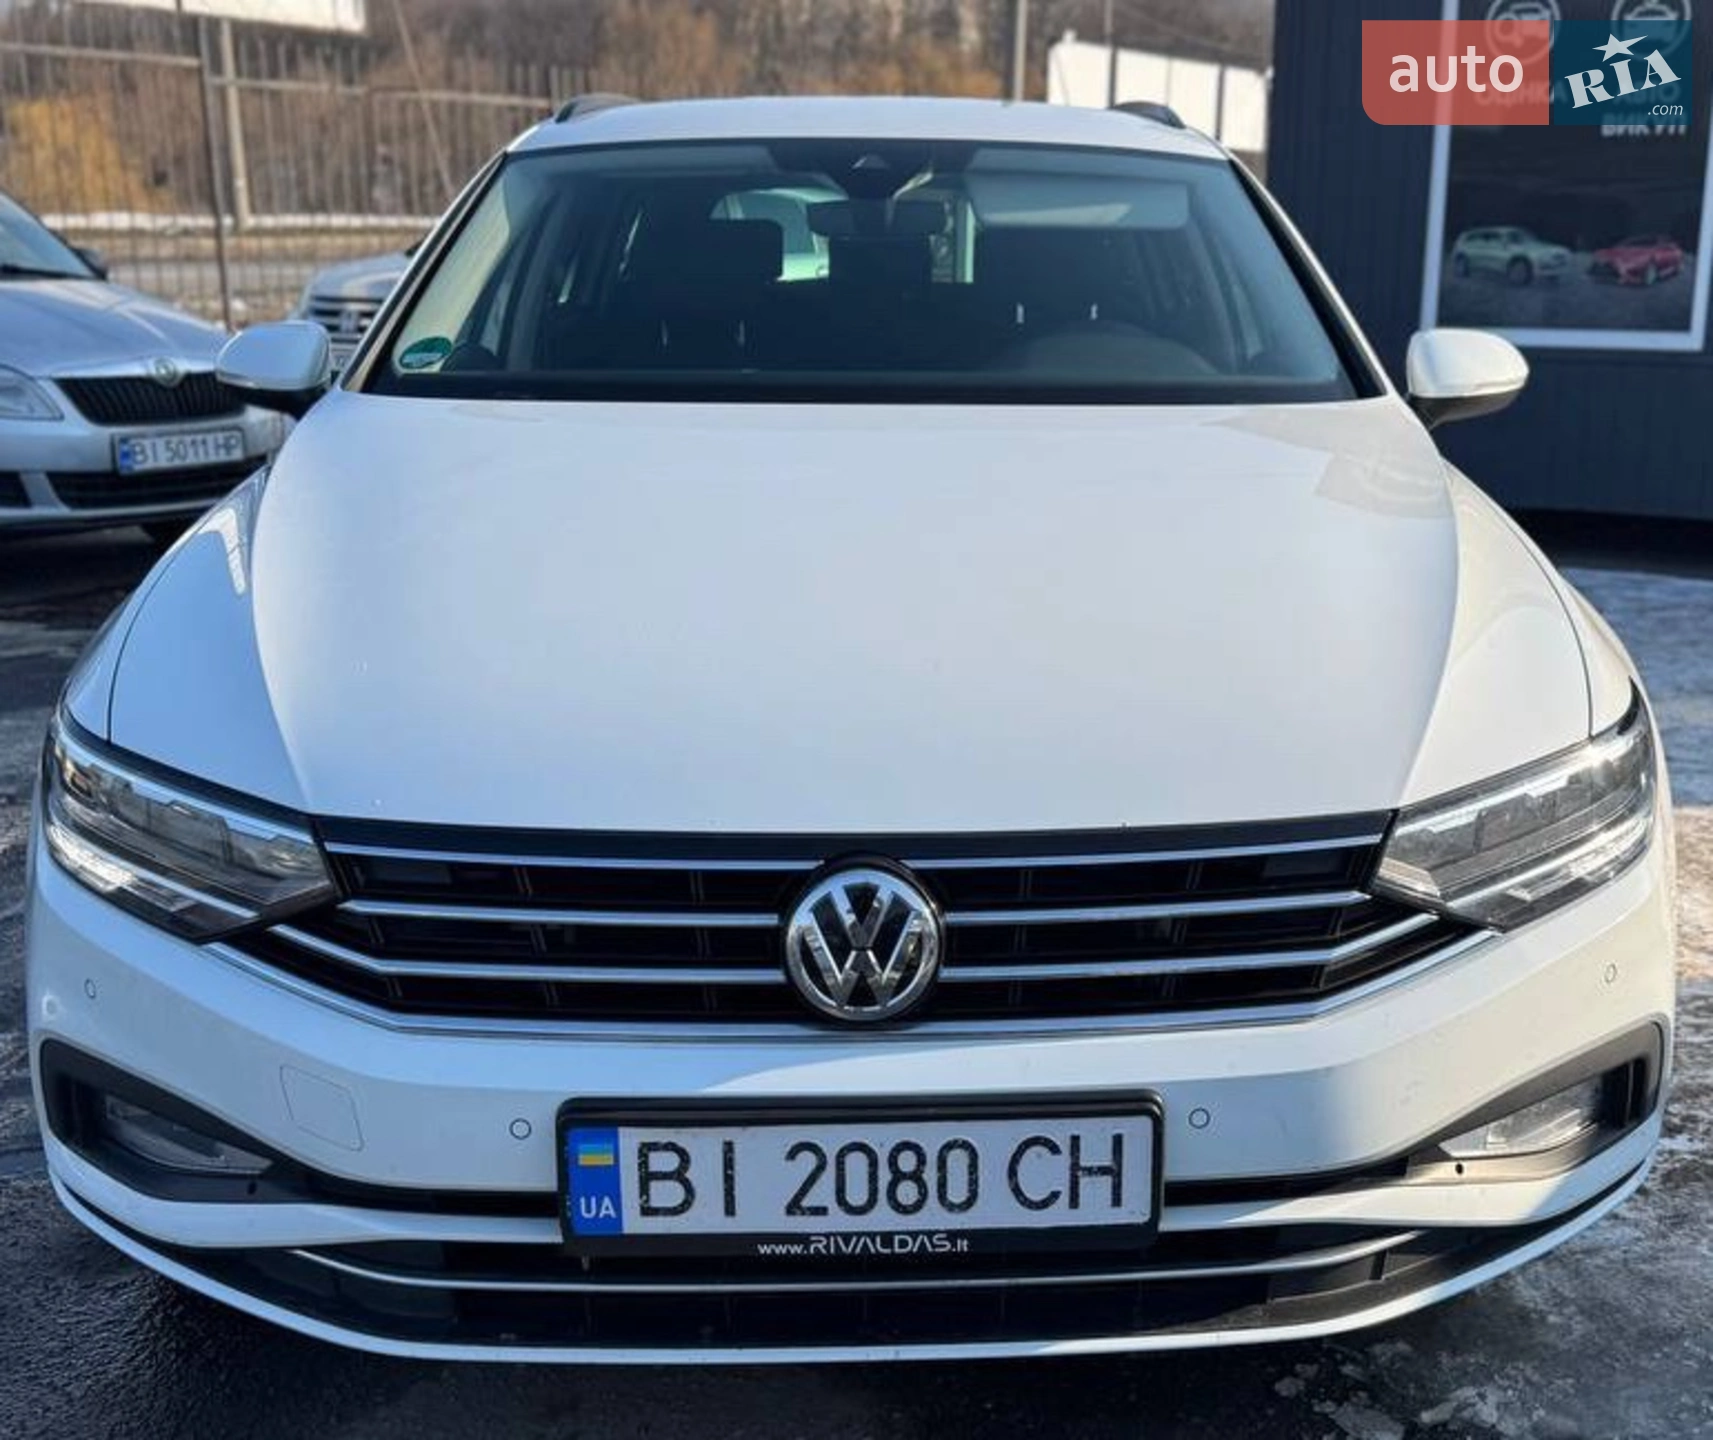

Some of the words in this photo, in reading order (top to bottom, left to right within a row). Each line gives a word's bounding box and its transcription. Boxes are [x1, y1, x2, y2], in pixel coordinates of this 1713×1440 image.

[637, 1141, 735, 1217] BI
[784, 1138, 980, 1217] 2080
[1006, 1132, 1125, 1211] CH
[580, 1196, 617, 1219] UA
